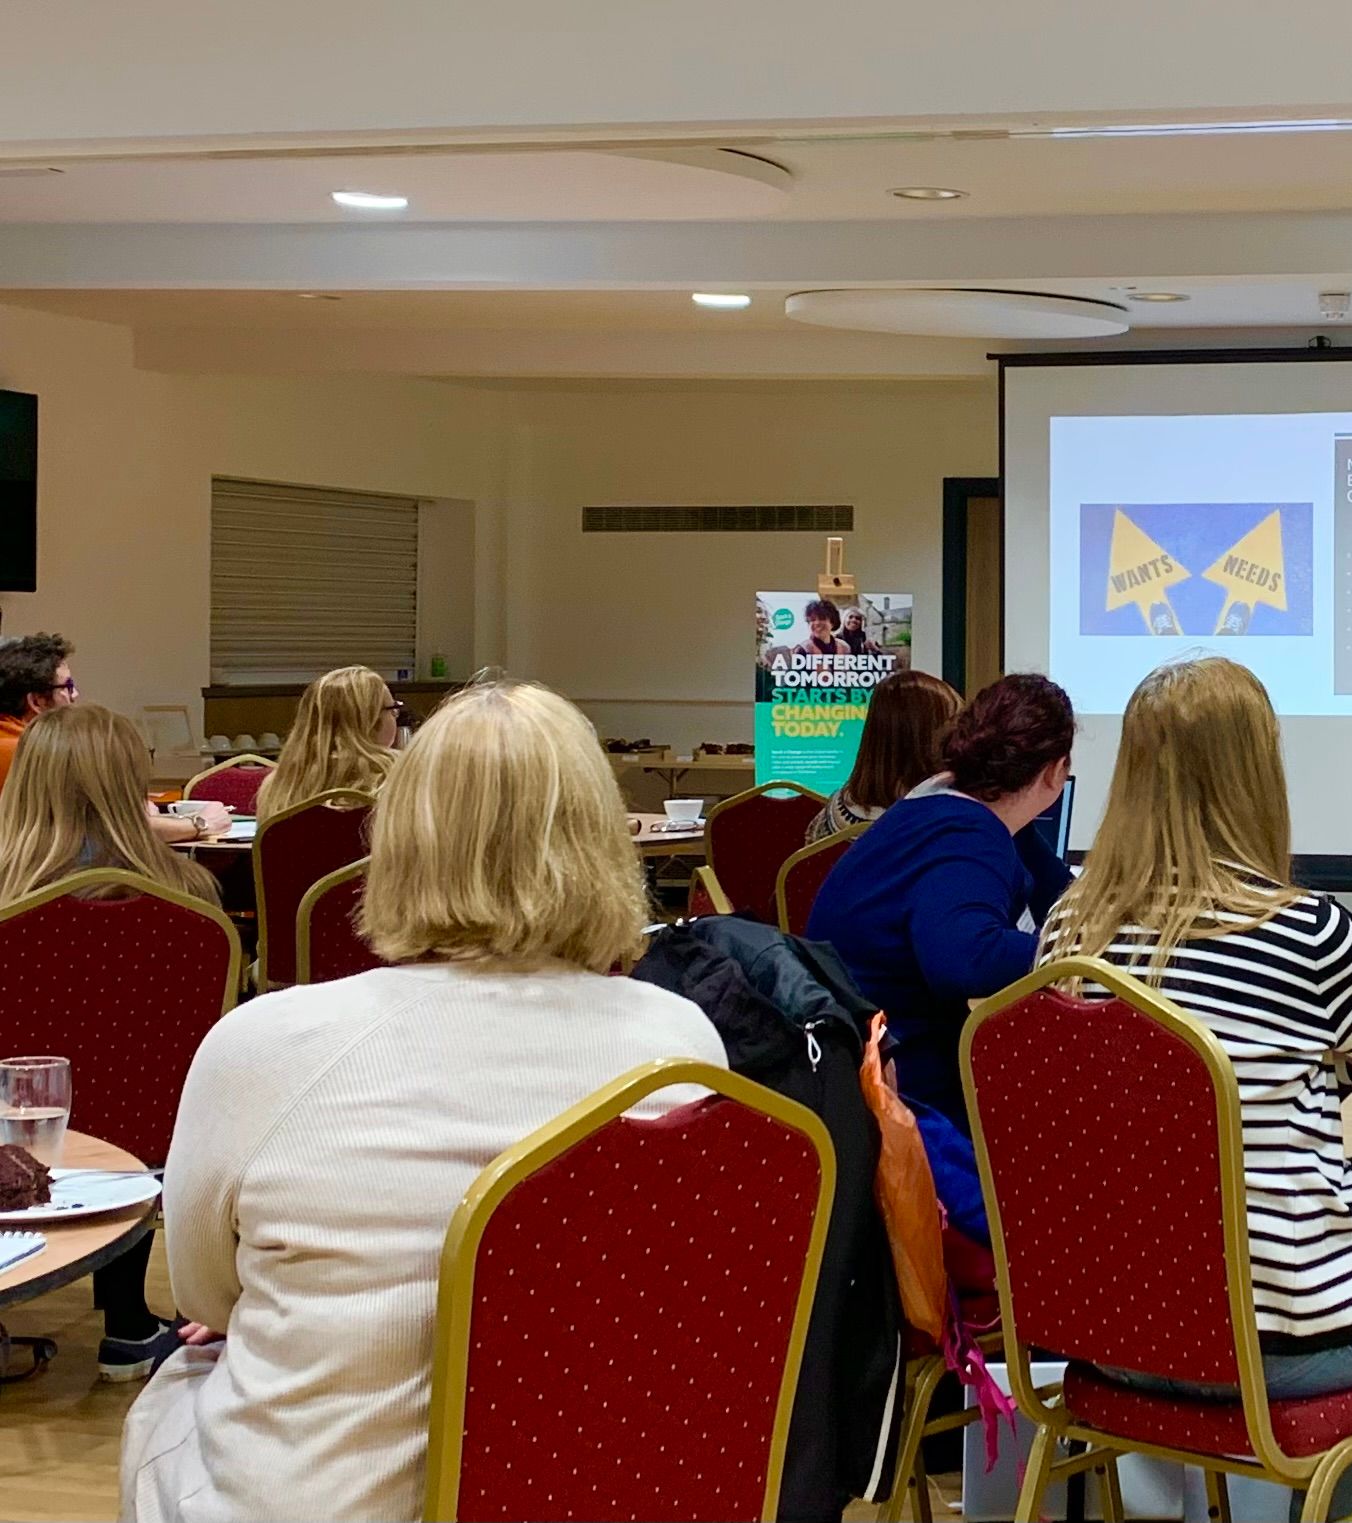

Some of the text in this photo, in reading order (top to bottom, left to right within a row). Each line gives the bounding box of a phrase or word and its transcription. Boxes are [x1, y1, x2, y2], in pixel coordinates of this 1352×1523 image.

[1110, 555, 1174, 594] WANTS
[1223, 555, 1281, 593] NEEDS
[771, 653, 897, 671] A DIFFERENT
[771, 687, 875, 704] STARTS BY
[771, 704, 867, 721] CHANGIN
[771, 720, 845, 738] TODAY.
